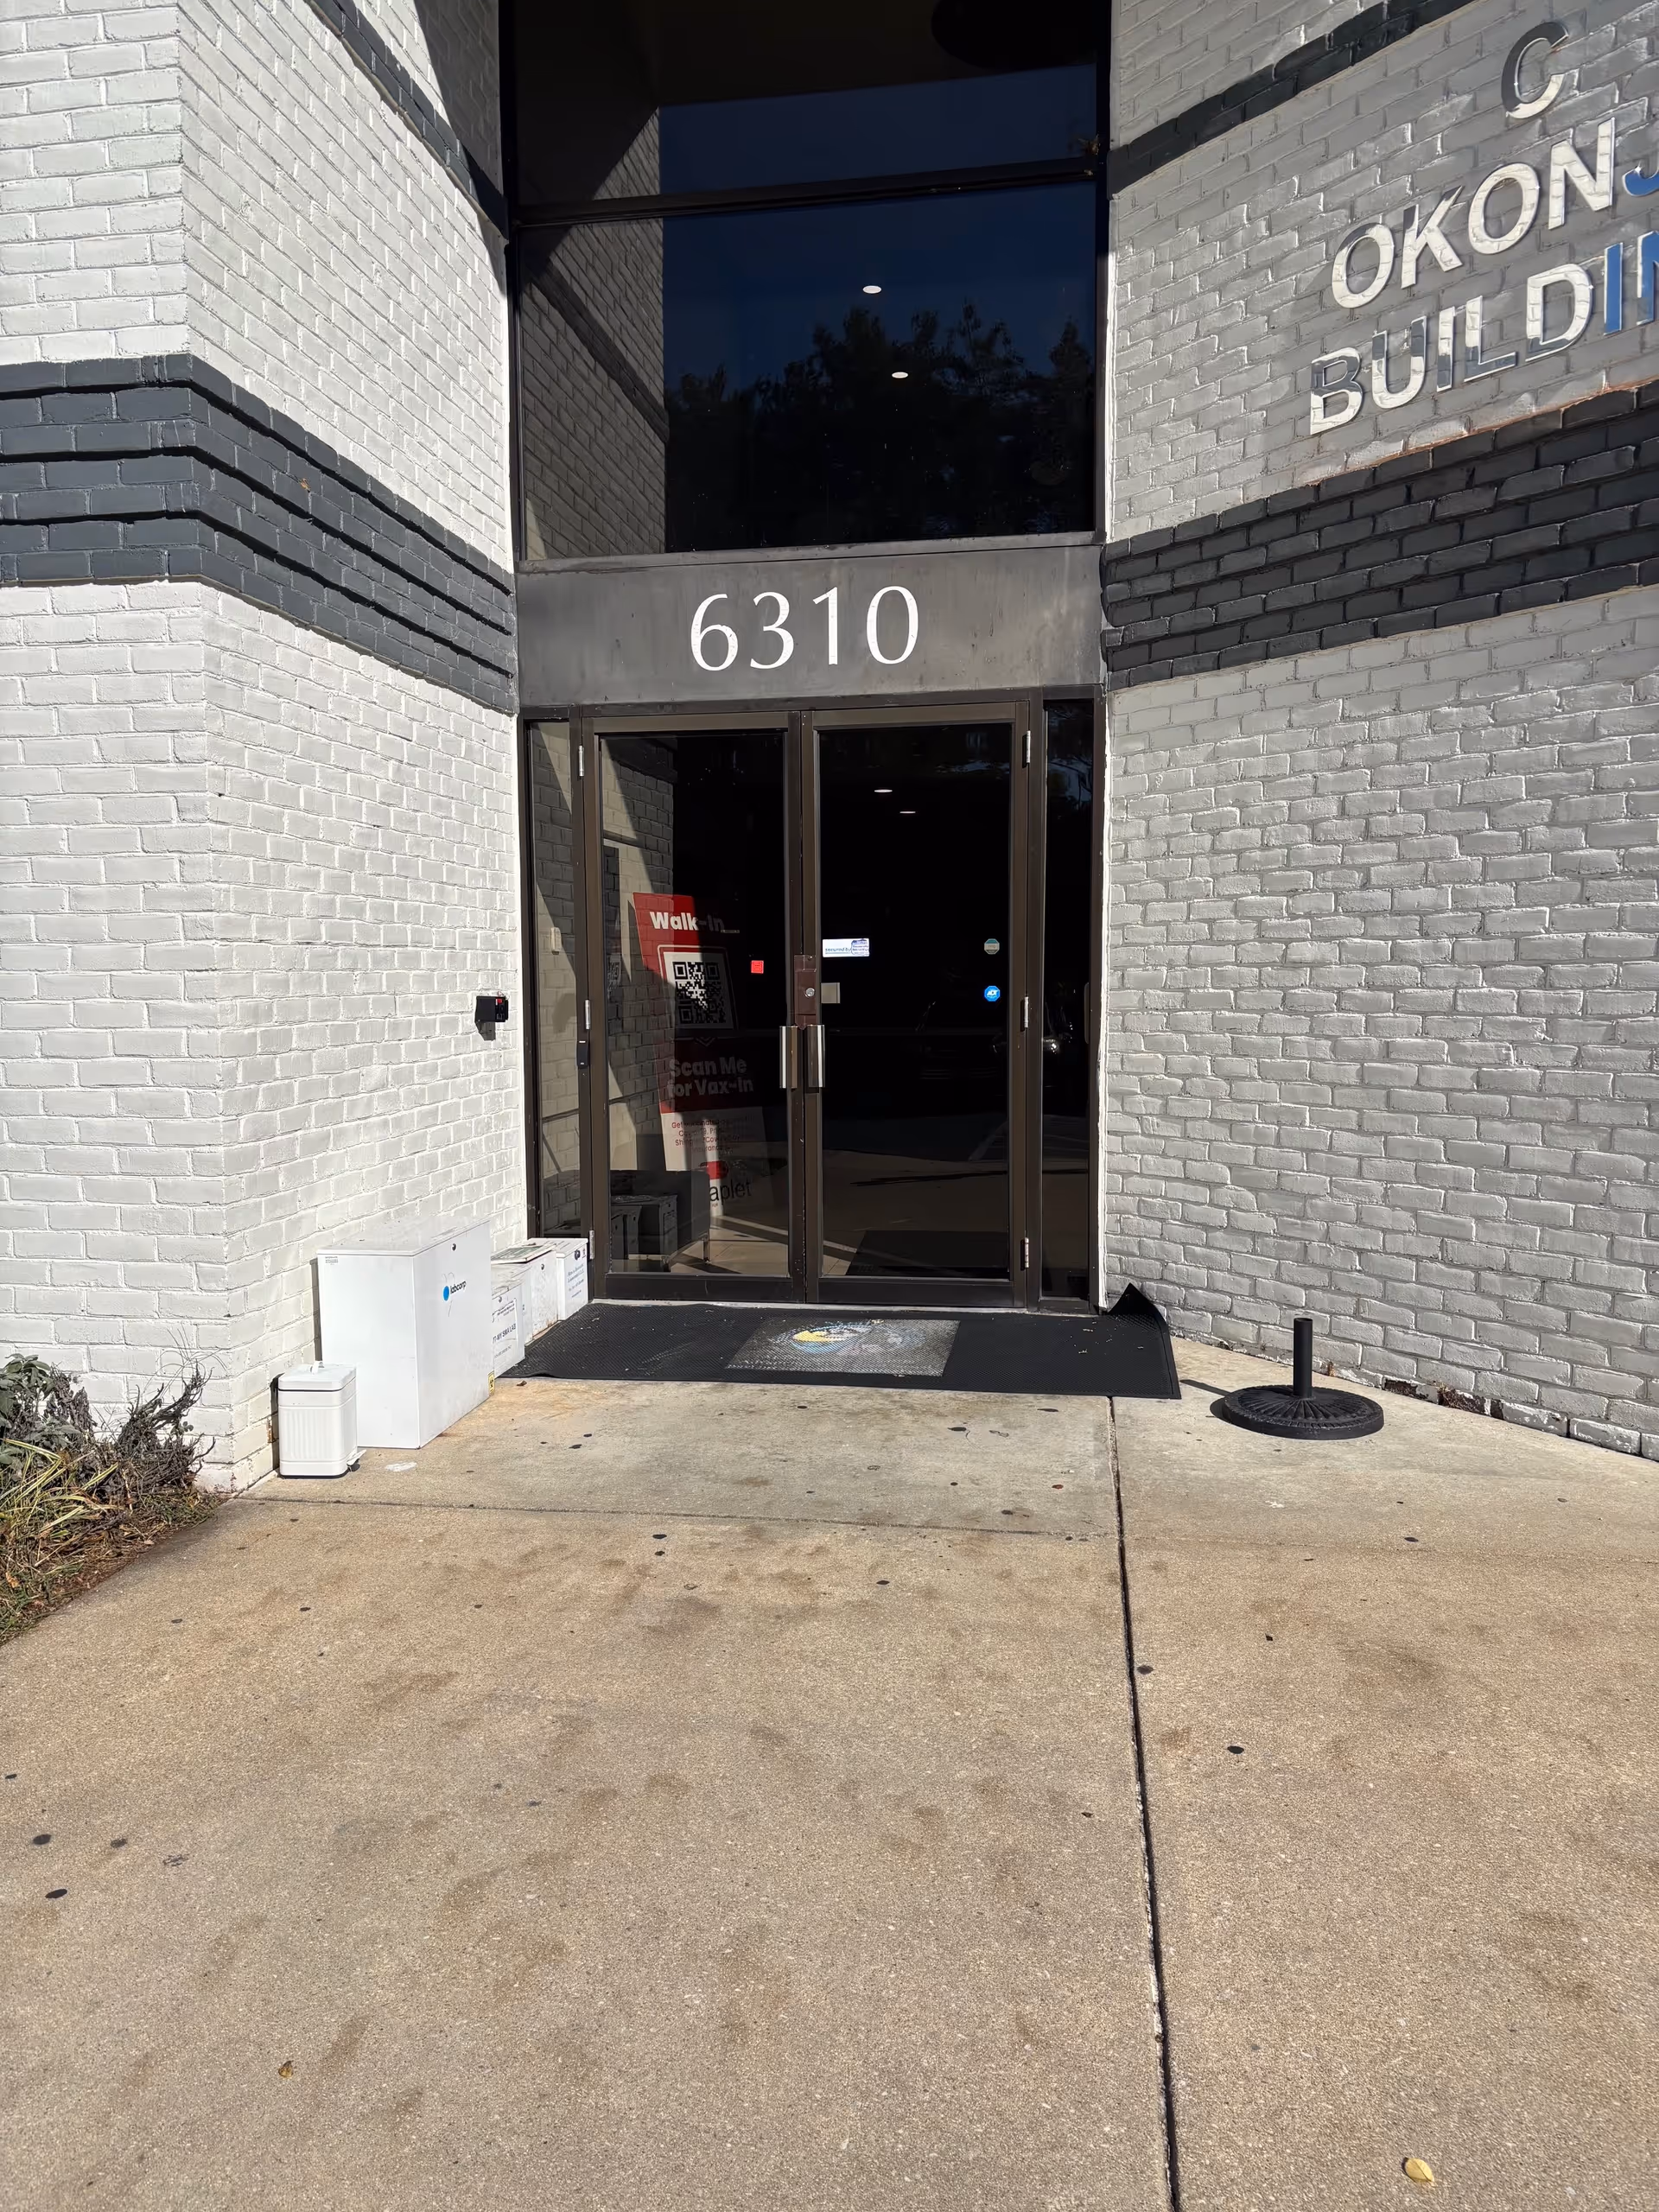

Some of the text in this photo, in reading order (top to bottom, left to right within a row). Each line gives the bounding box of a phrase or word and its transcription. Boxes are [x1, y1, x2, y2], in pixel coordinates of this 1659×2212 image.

[1502, 22, 1568, 118] C
[690, 585, 919, 671] 6310
[649, 911, 726, 932] Walk-In
[669, 1056, 747, 1077] Scan Me
[666, 1077, 754, 1097] for Vax-In
[449, 1280, 467, 1295] labcorp
